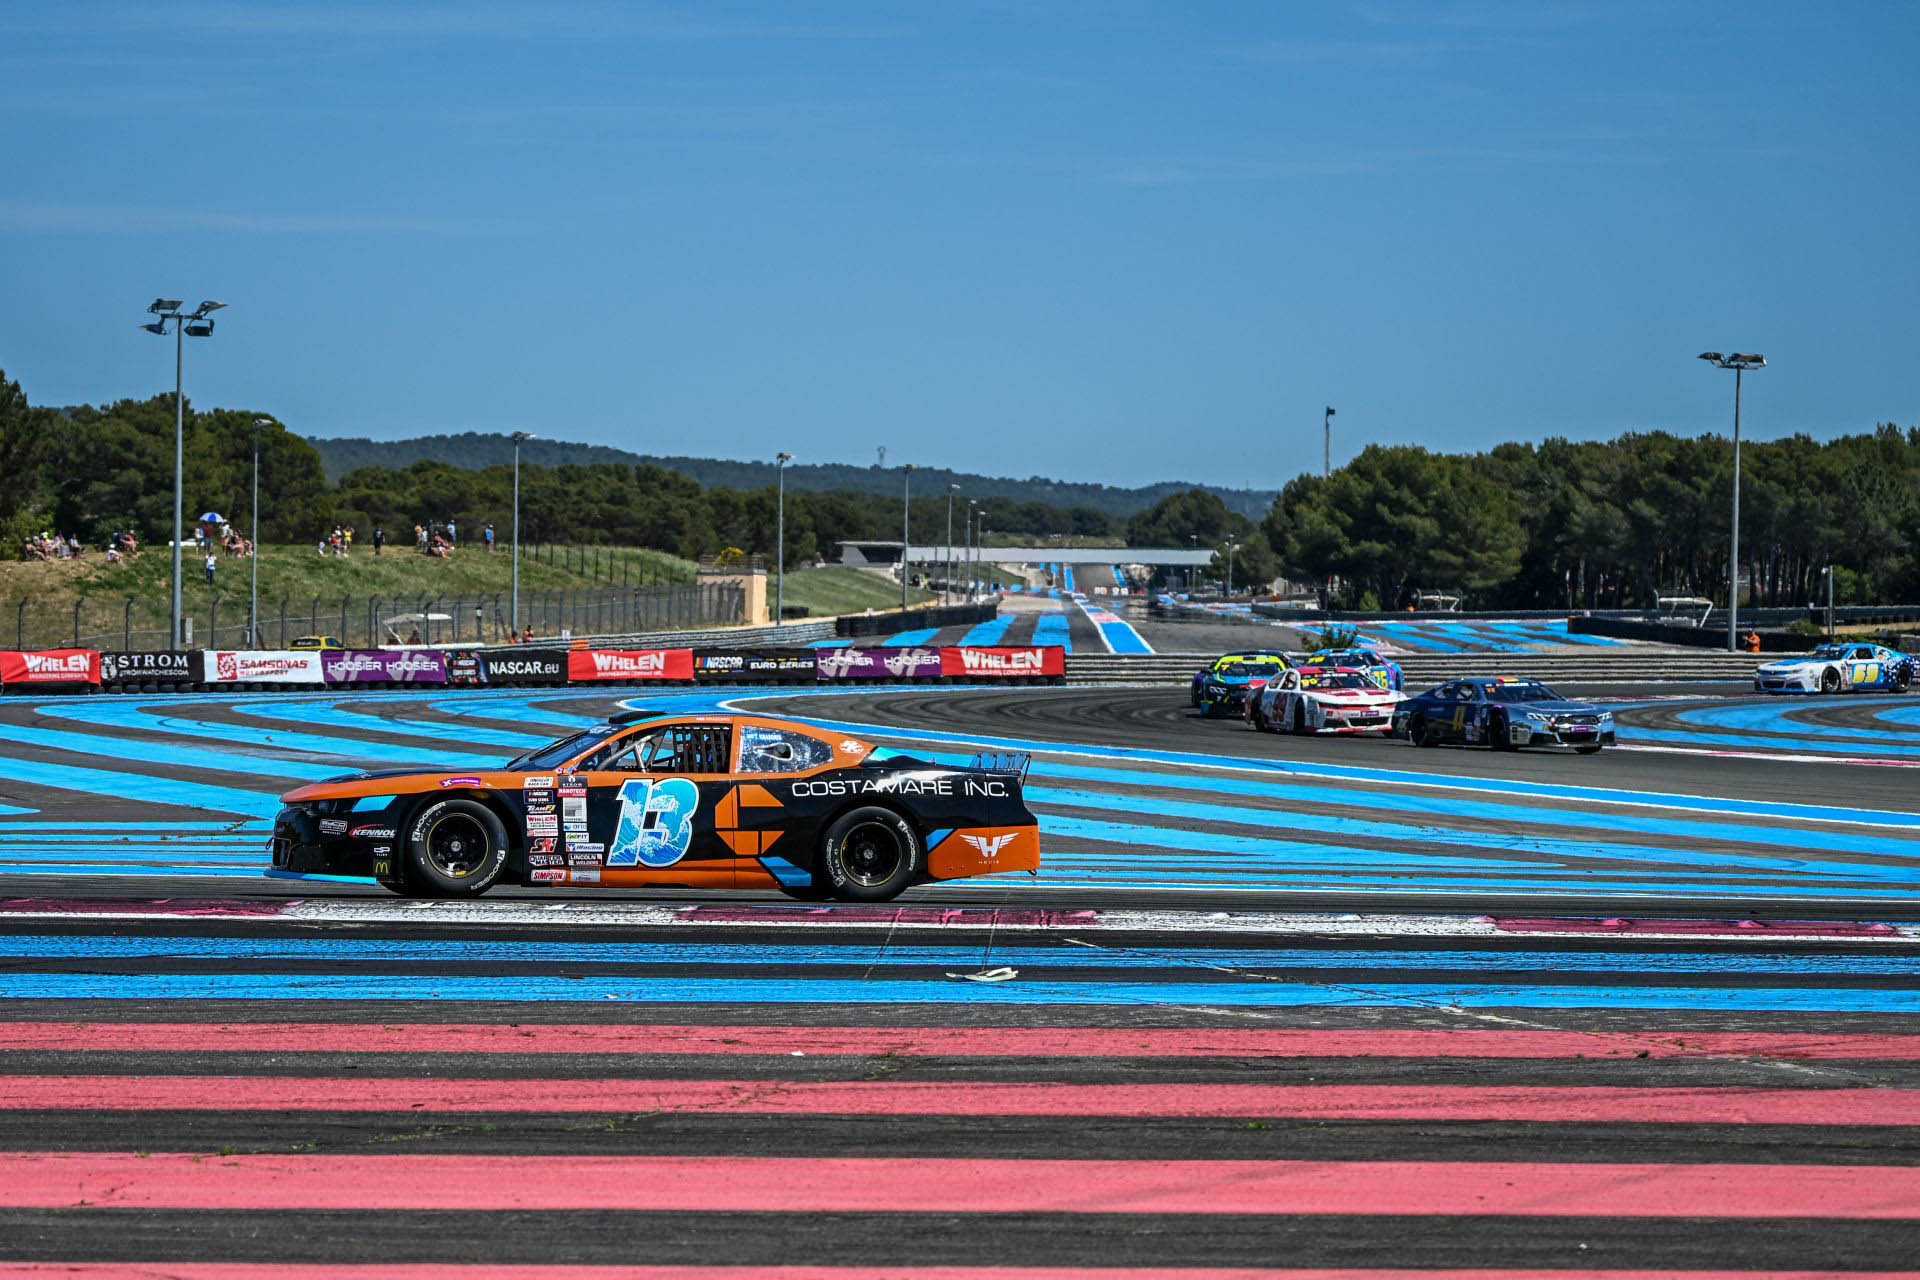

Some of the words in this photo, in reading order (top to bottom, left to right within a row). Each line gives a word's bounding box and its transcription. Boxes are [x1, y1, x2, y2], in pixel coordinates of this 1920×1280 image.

[23, 653, 90, 672] WHELEN
[118, 654, 189, 668] STROM
[239, 659, 308, 669] SAMSONAS
[592, 651, 665, 671] WHELEN
[706, 656, 743, 669] NASCAR
[750, 661, 776, 669] EURO
[779, 661, 814, 669] SERIES
[818, 656, 873, 666] HOOSIER
[884, 655, 940, 666] HOOSIER
[960, 648, 1043, 669] WHELEN
[327, 660, 382, 672] HOOSIER
[386, 661, 439, 671] HOOSIER
[489, 661, 560, 674] NASCAR.eu
[792, 779, 953, 797] COSTAMARE
[964, 780, 1009, 797] INC.
[605, 777, 700, 868] 13
[352, 829, 396, 837] KENNOL
[533, 872, 564, 880] SIMPSON
